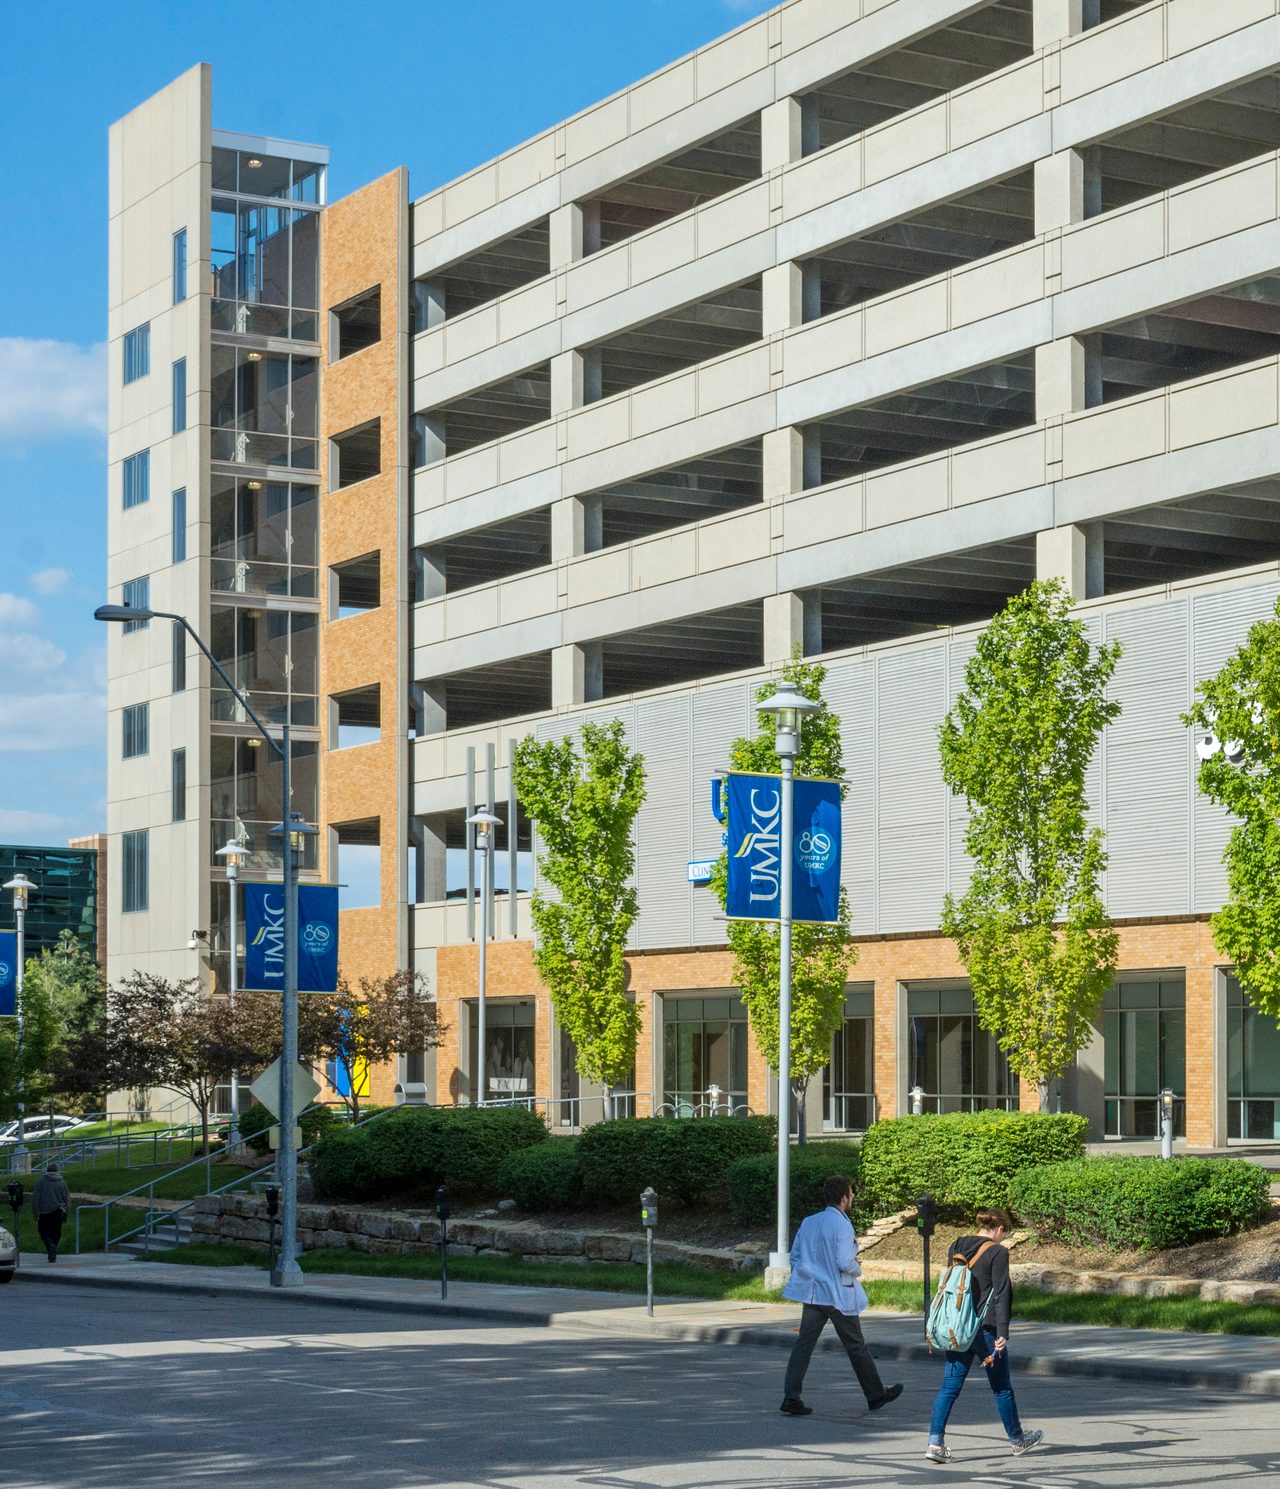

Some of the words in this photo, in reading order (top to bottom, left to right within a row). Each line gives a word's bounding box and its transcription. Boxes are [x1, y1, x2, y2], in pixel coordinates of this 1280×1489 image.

[742, 788, 780, 904] UMKC
[799, 831, 831, 855] 80
[799, 854, 820, 862] years
[820, 853, 830, 861] of
[804, 861, 825, 869] UMKC
